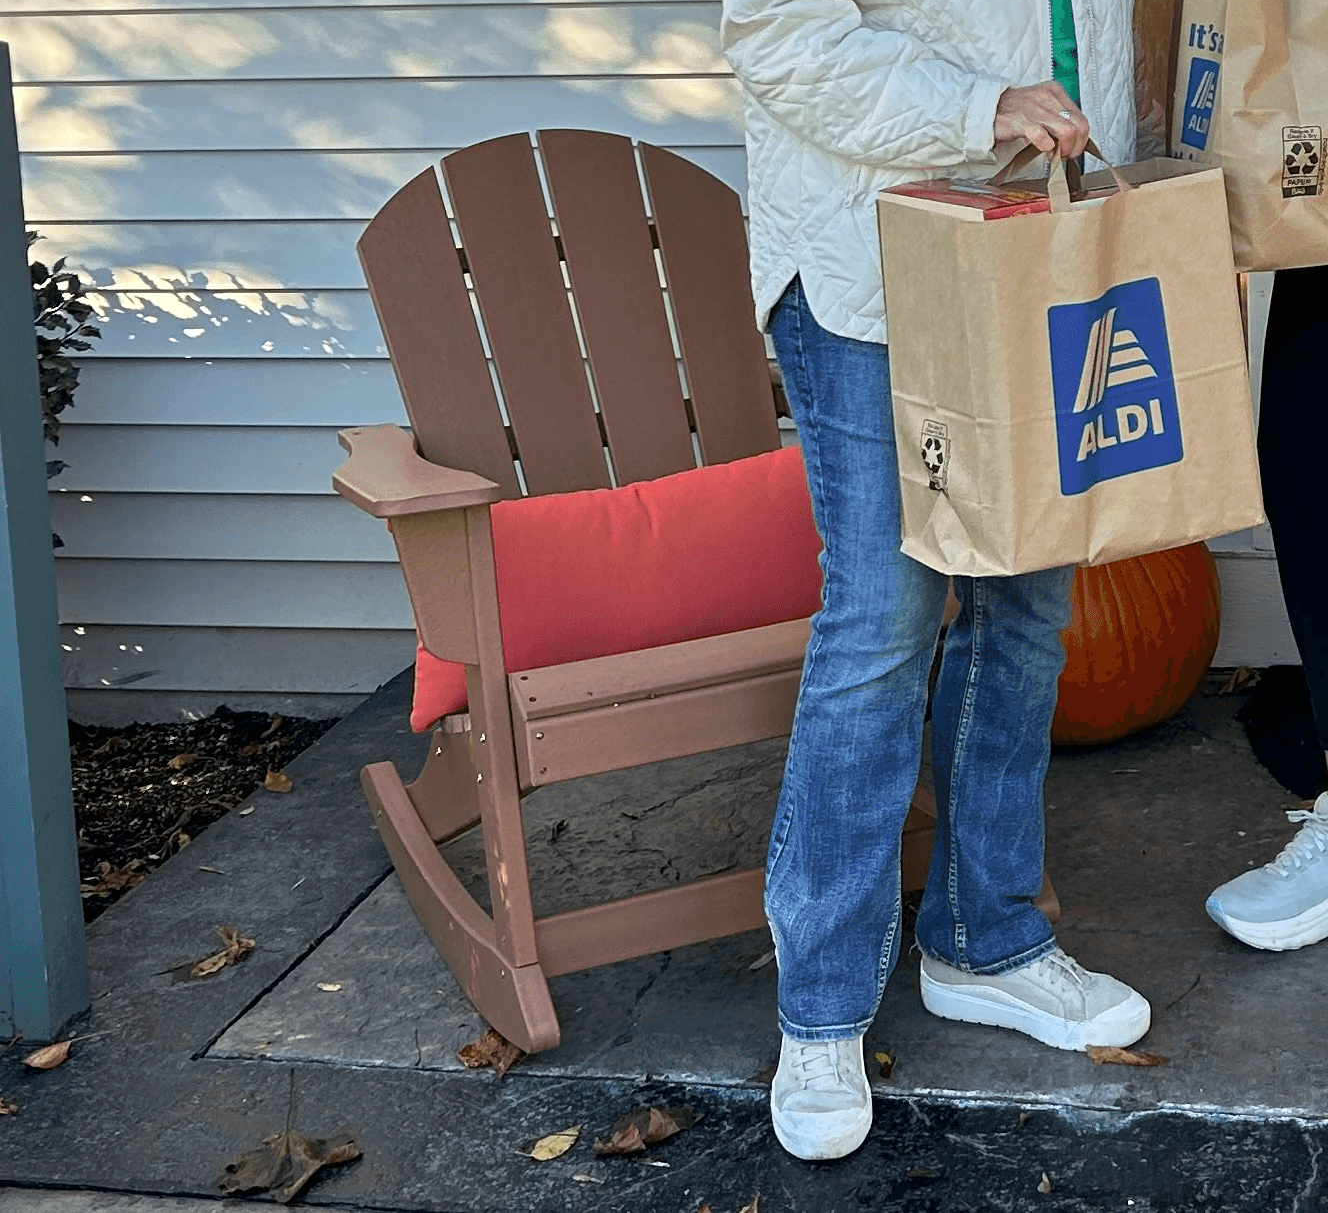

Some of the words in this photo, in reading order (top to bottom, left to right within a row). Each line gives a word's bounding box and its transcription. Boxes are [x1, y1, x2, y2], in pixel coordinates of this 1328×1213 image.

[1188, 23, 1219, 52] It's
[1188, 113, 1211, 136] ALD
[1076, 398, 1165, 462] ALDI
